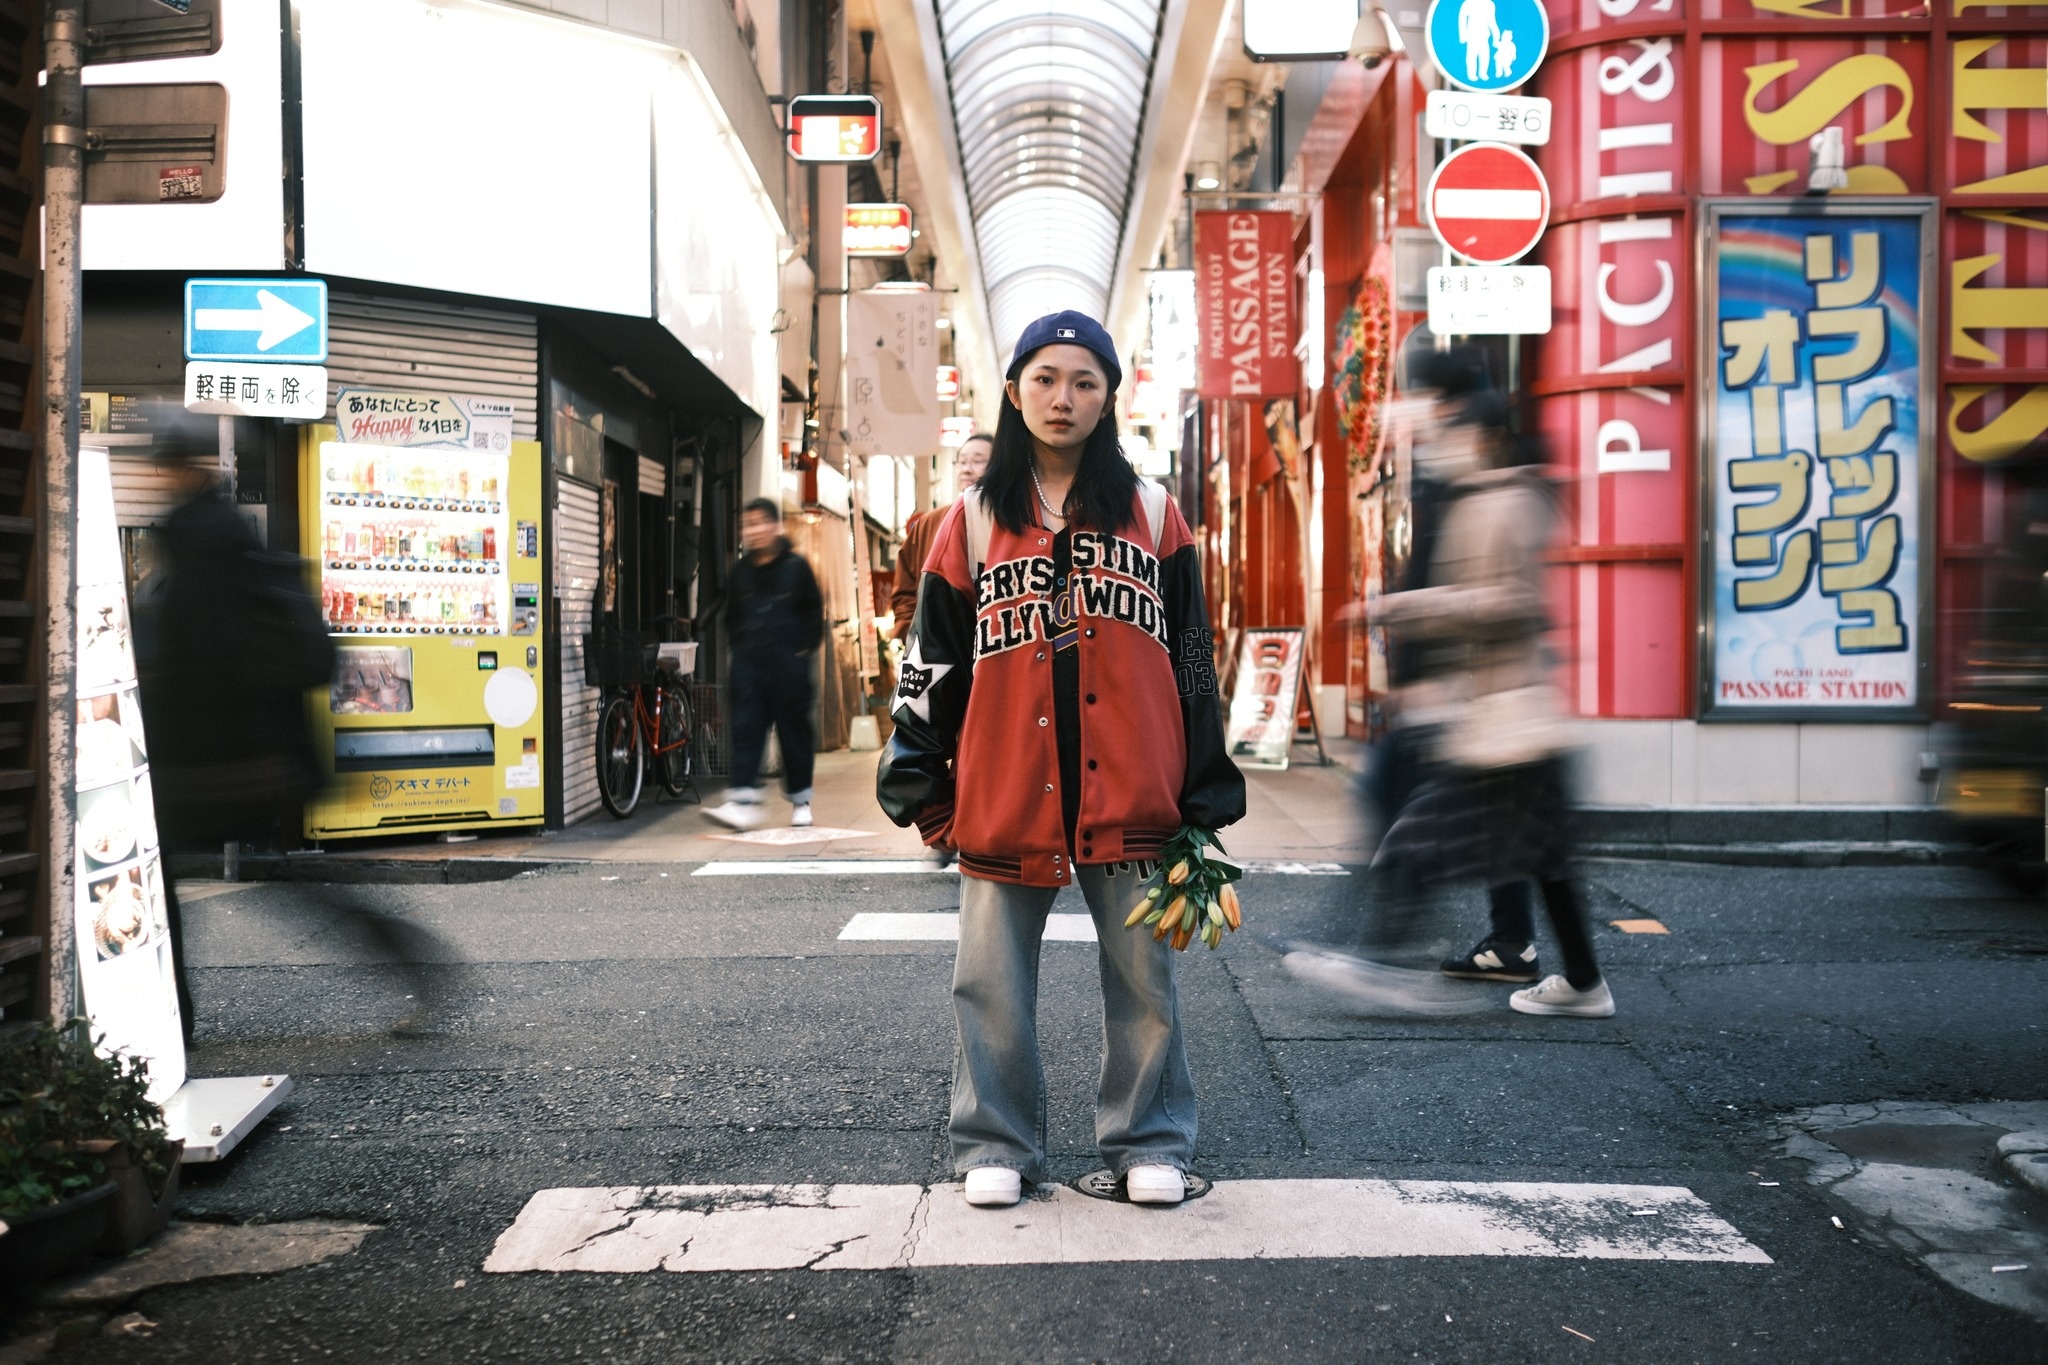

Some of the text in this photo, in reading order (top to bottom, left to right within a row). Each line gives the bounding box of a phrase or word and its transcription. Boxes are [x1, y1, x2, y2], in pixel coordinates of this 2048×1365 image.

[1208, 253, 1224, 359] PACHI&SLOT
[1228, 213, 1262, 396] PASSAGE
[1266, 252, 1287, 358] STATION
[196, 374, 315, 404] 軽車両を除く
[349, 396, 440, 414] あなたにとって
[351, 414, 417, 442] Happy
[1805, 231, 1908, 653] リフレッシュ
[1721, 309, 1813, 610] オープン
[1775, 668, 1853, 677] PACHI LAND
[1722, 680, 1907, 699] PASSAGE STATION
[395, 779, 431, 791] スキマ
